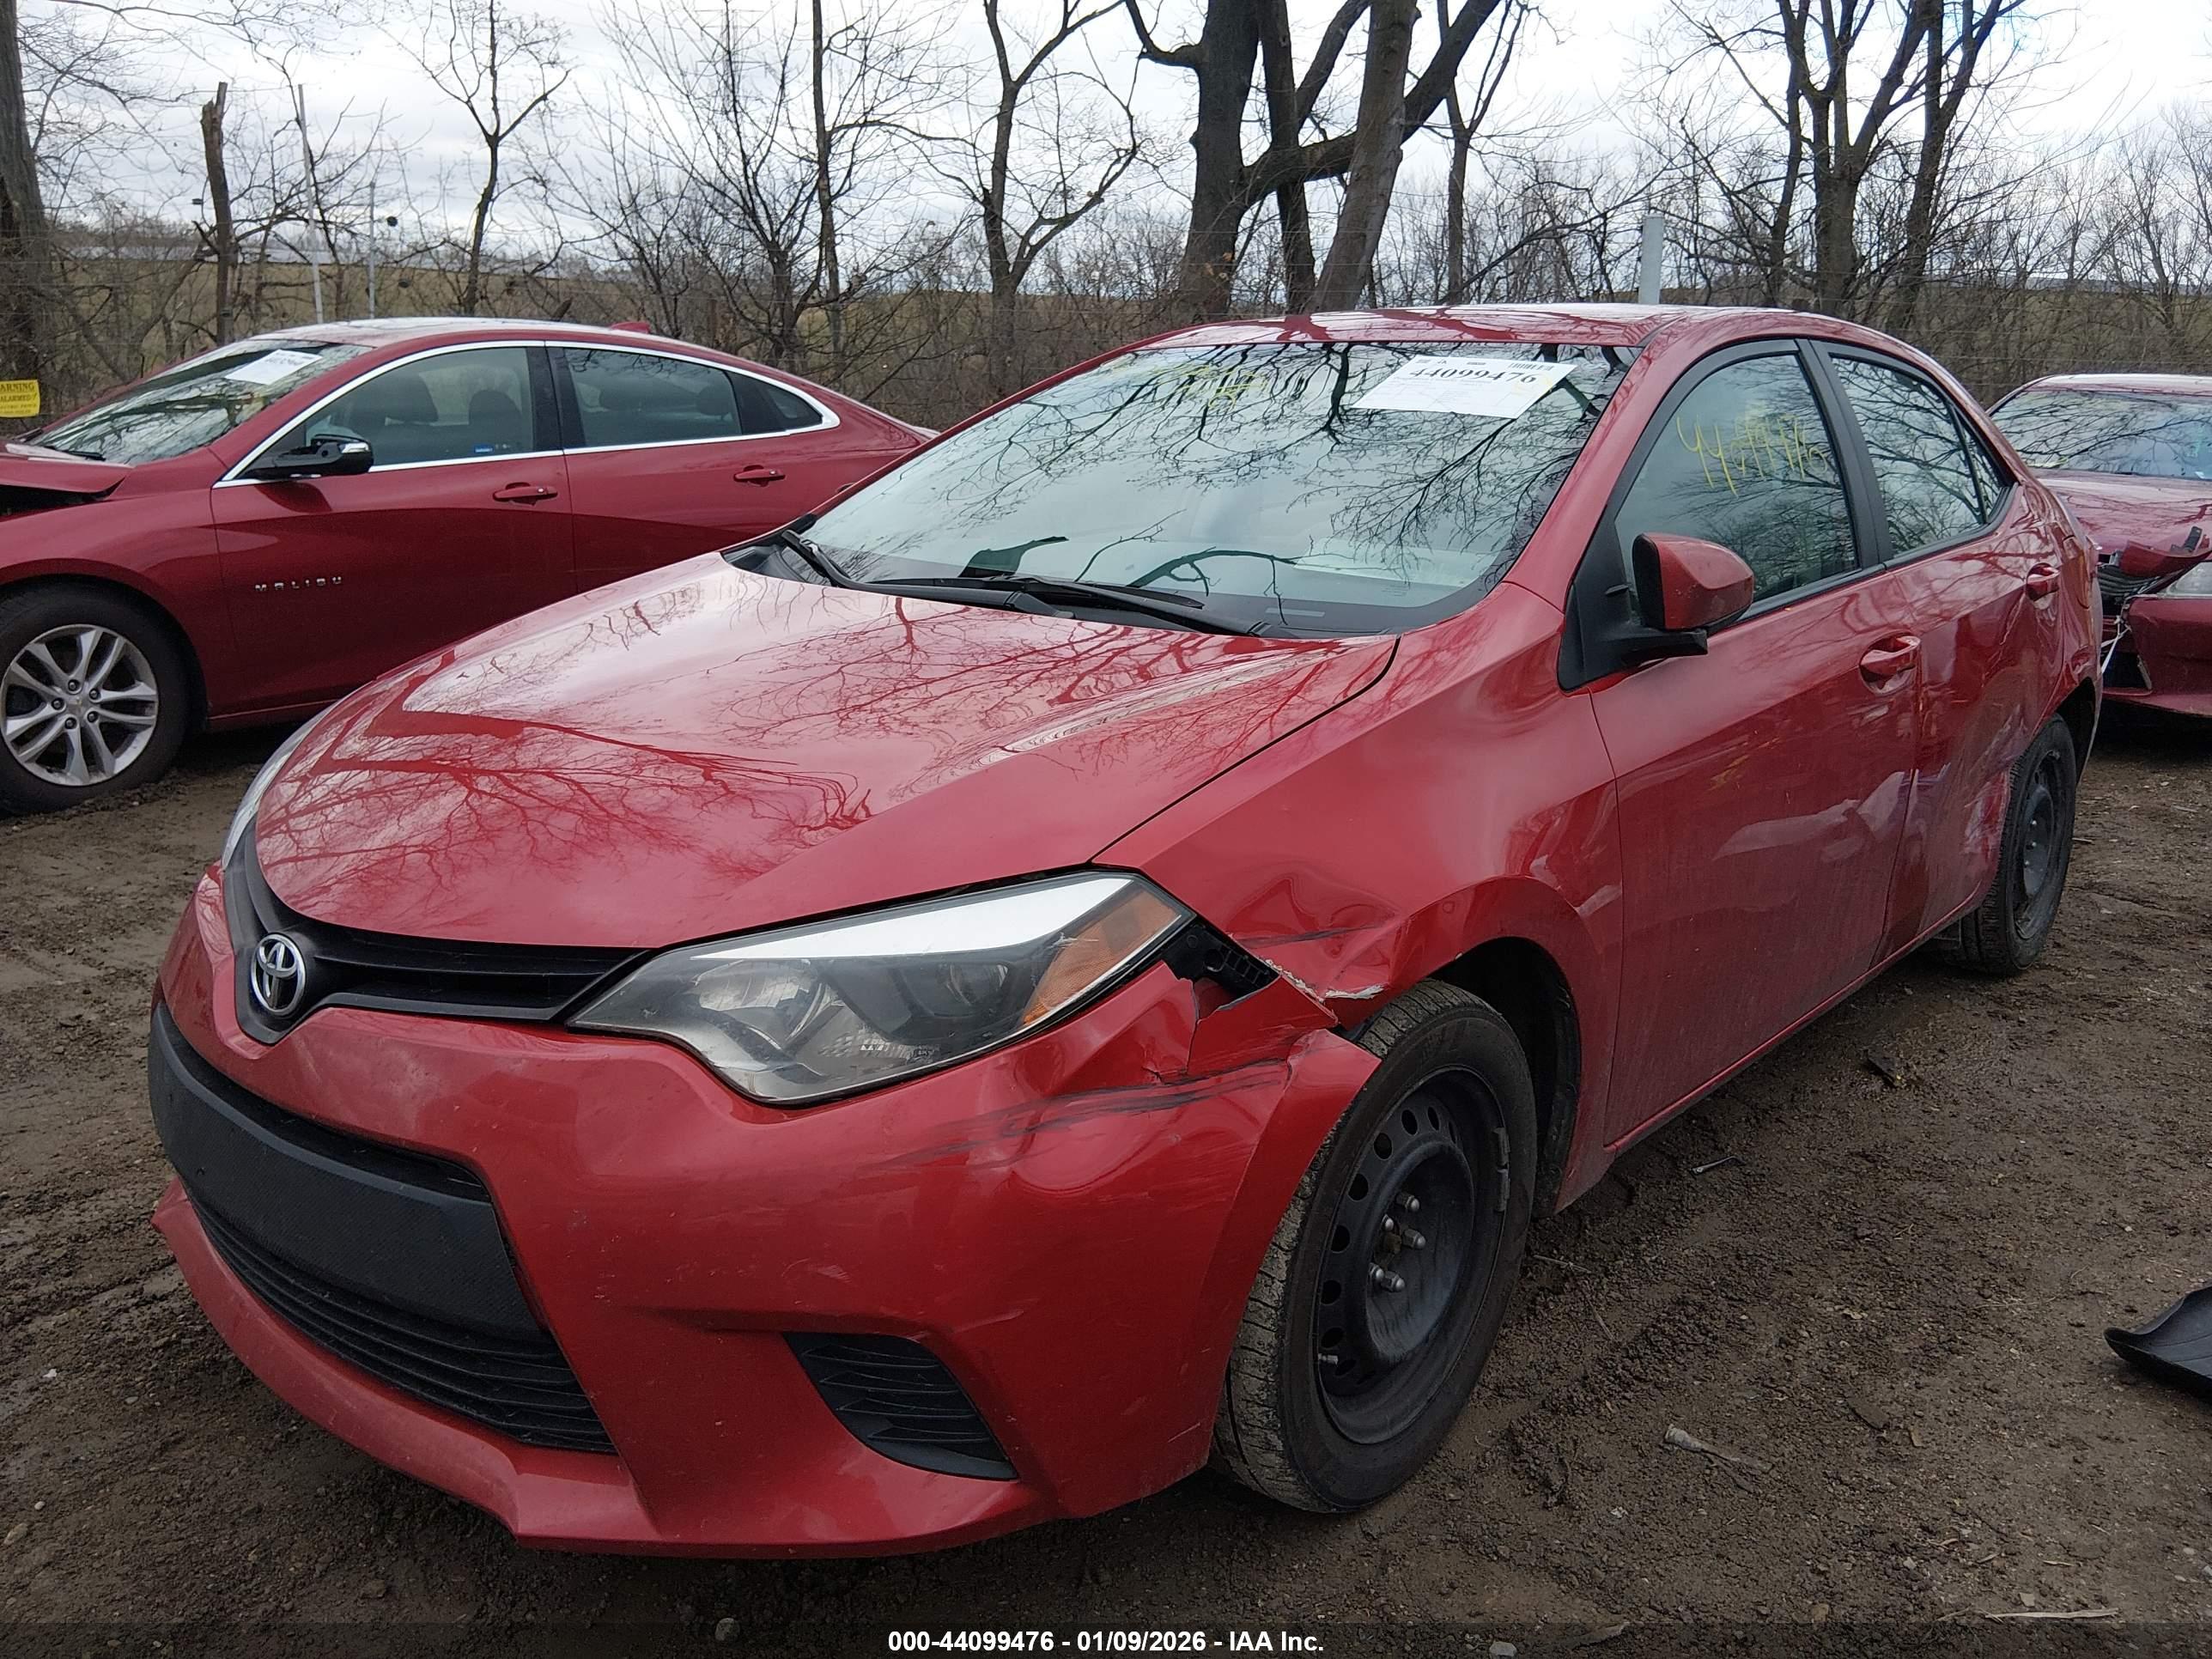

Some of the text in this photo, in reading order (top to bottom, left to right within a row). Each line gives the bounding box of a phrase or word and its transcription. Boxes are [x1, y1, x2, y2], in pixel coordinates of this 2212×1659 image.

[1410, 368, 1538, 383] 44099476
[0, 382, 35, 392] ARNING
[254, 576, 342, 591] MALIBU
